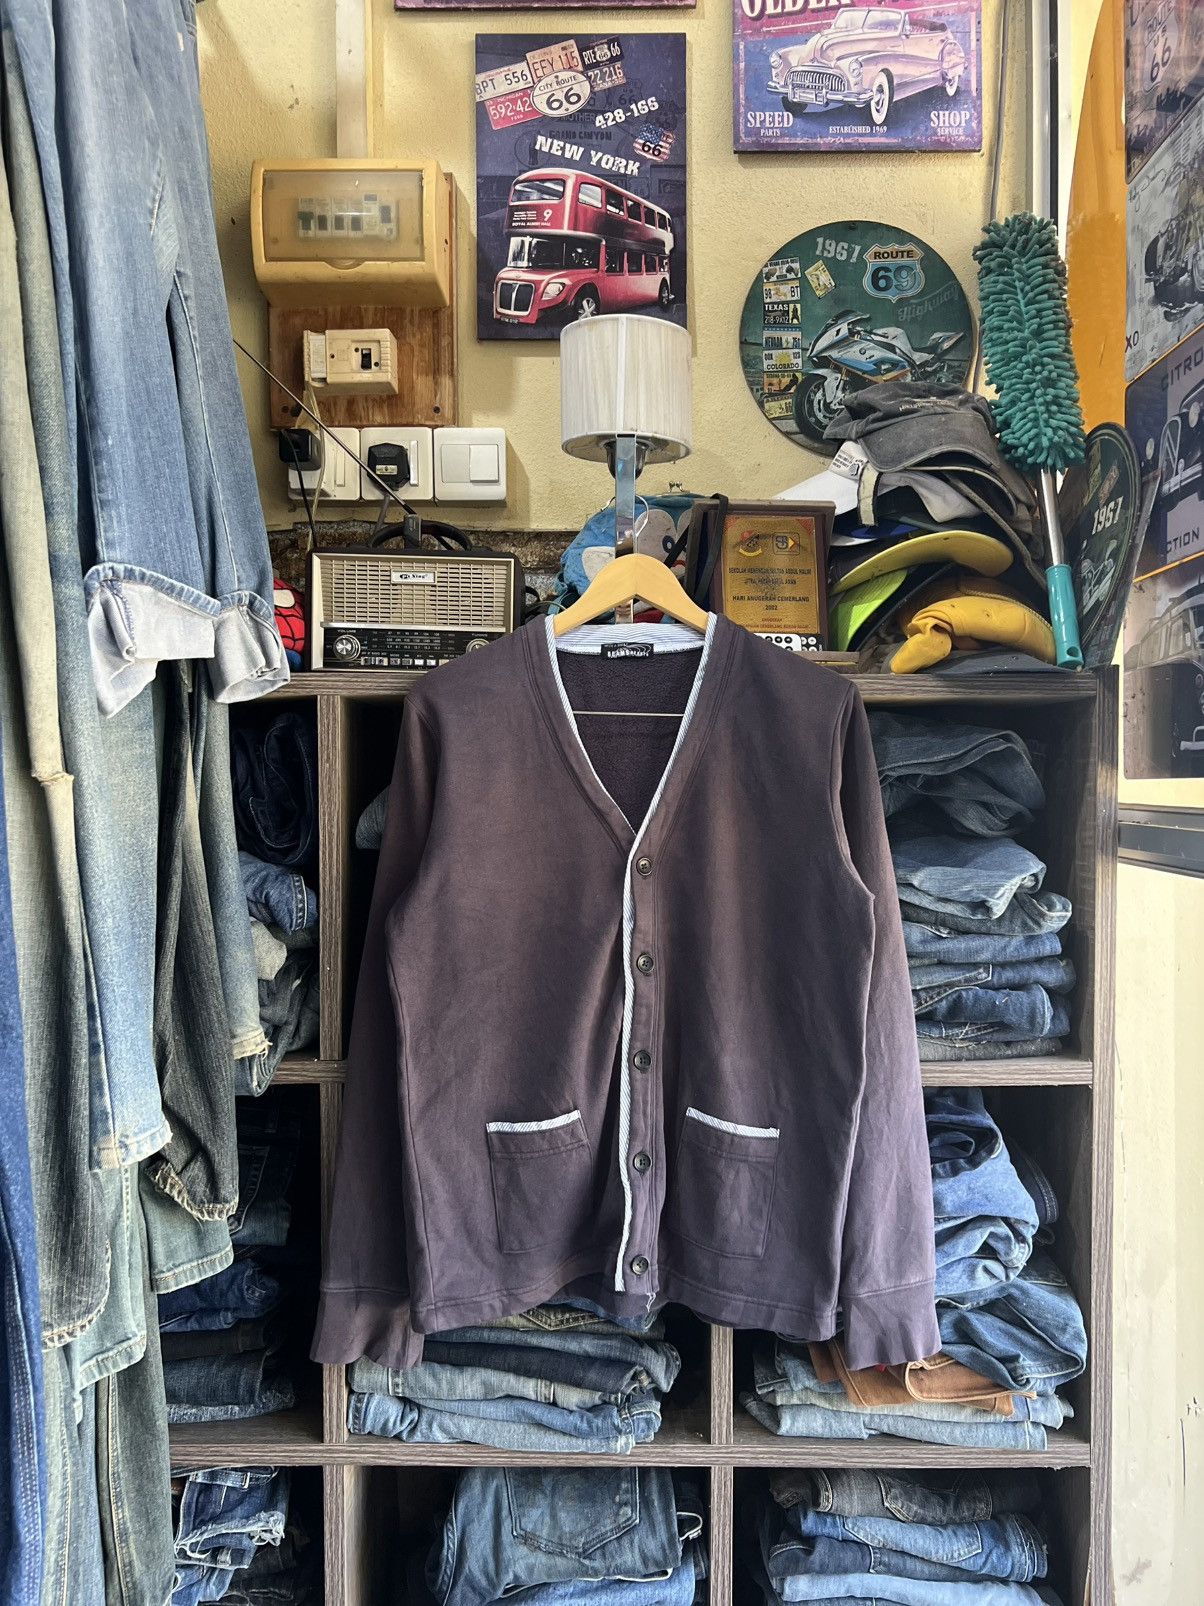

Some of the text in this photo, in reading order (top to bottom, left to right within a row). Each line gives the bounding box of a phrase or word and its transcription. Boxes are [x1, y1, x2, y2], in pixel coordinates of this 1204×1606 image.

[611, 42, 621, 56] 66
[1151, 37, 1171, 83] 66
[504, 70, 529, 86] 556
[603, 65, 623, 81] 216
[539, 75, 577, 92] CITY ROUTE
[546, 86, 582, 111] 66
[595, 97, 659, 128] 428-166
[747, 111, 970, 128] SPEED SHOP
[760, 128, 781, 136] PARTS
[829, 125, 871, 134] ESTABLISHED
[937, 128, 964, 136] SERVICE
[534, 134, 641, 176] NEW YORK
[642, 140, 663, 156] 66
[544, 209, 553, 221] 9
[815, 237, 861, 263] 1967
[874, 250, 914, 260] ROUTE
[871, 265, 917, 292] 69
[766, 362, 800, 370] COLORADO
